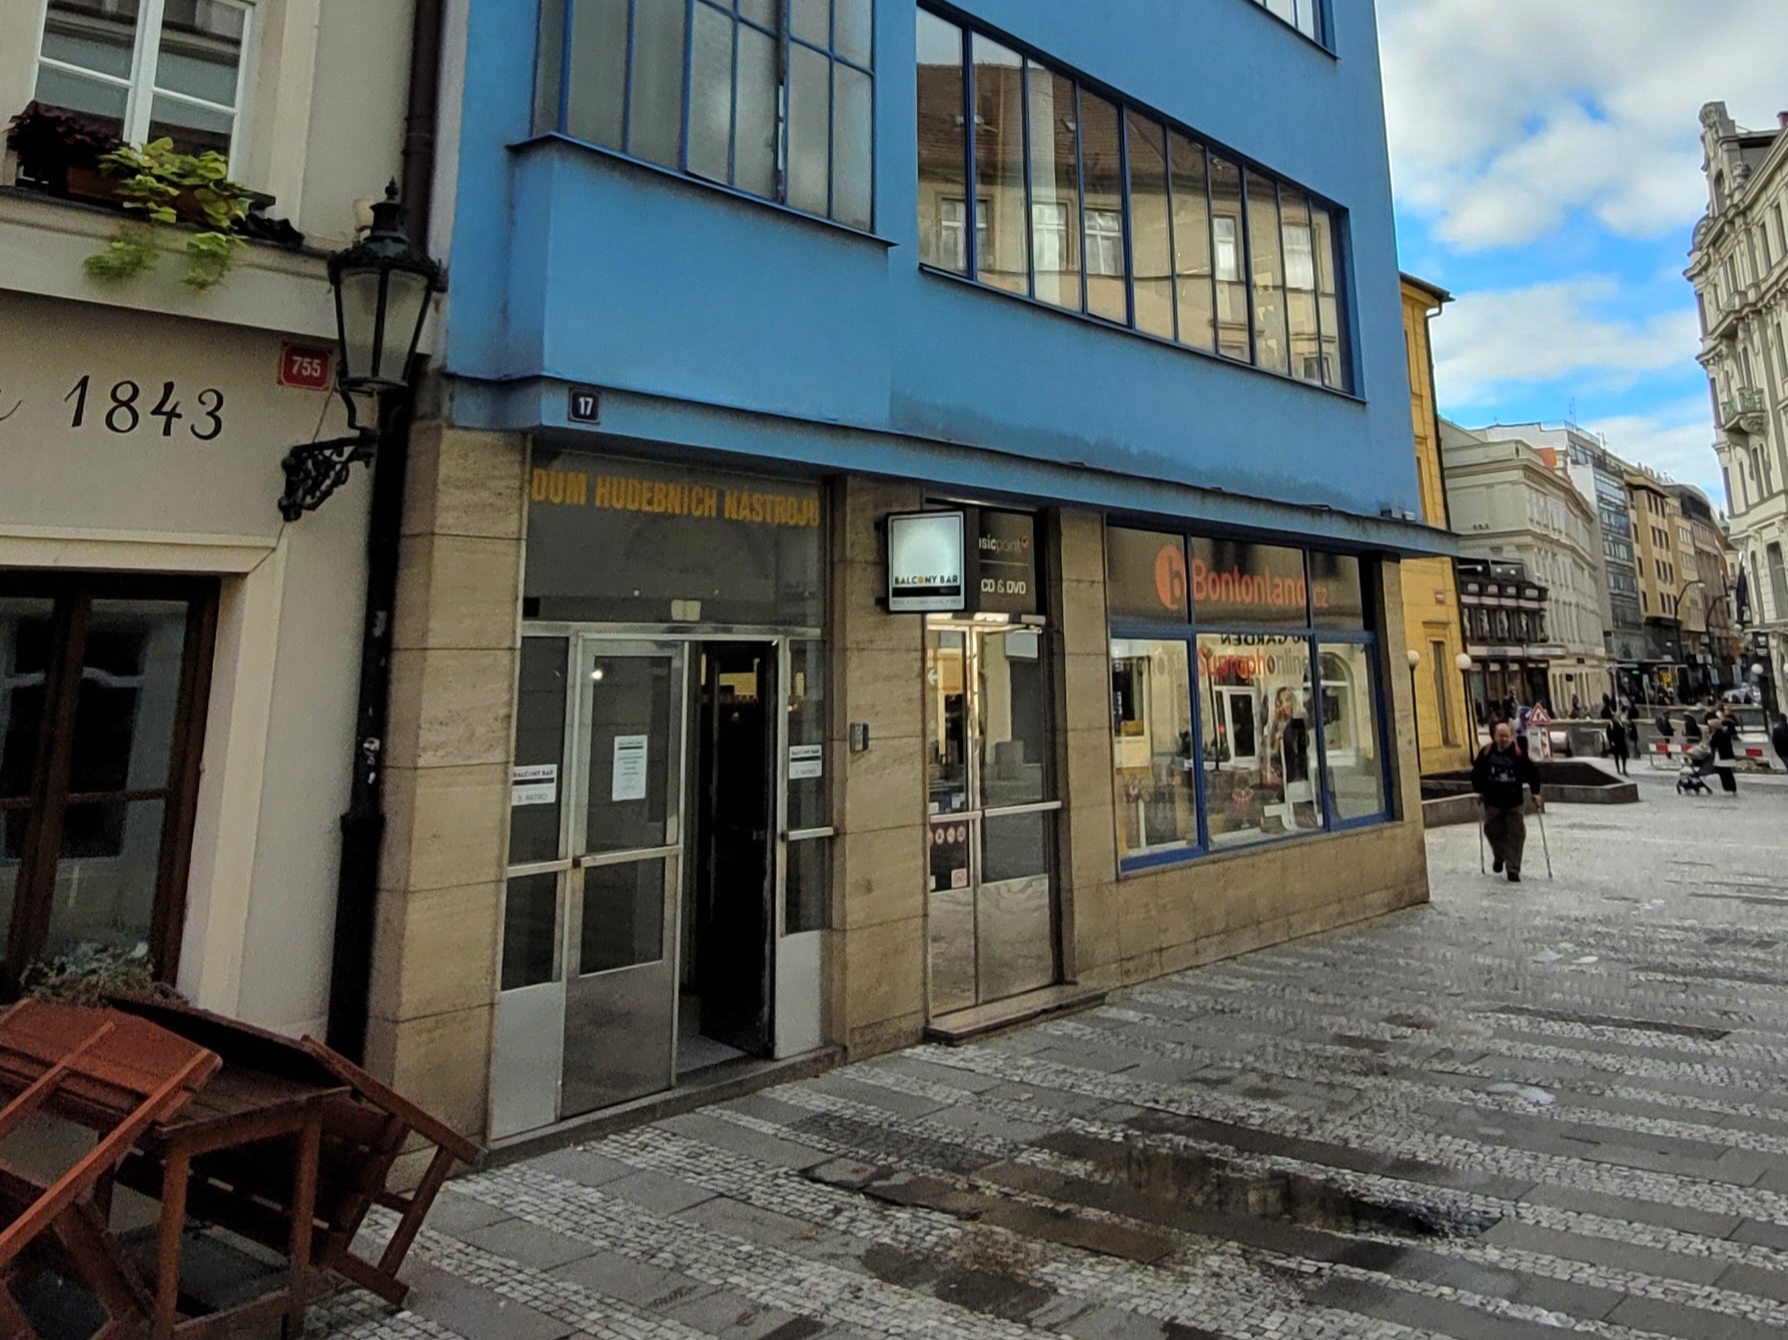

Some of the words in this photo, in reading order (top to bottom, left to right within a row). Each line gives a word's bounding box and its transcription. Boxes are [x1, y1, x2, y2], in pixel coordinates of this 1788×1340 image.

[292, 355, 322, 377] 755
[64, 374, 225, 441] 1843
[579, 396, 593, 415] 17
[894, 575, 937, 586] BALCONY
[940, 575, 958, 585] BAR
[981, 578, 996, 593] CD
[997, 579, 1005, 593] &
[1006, 580, 1026, 594] DVD
